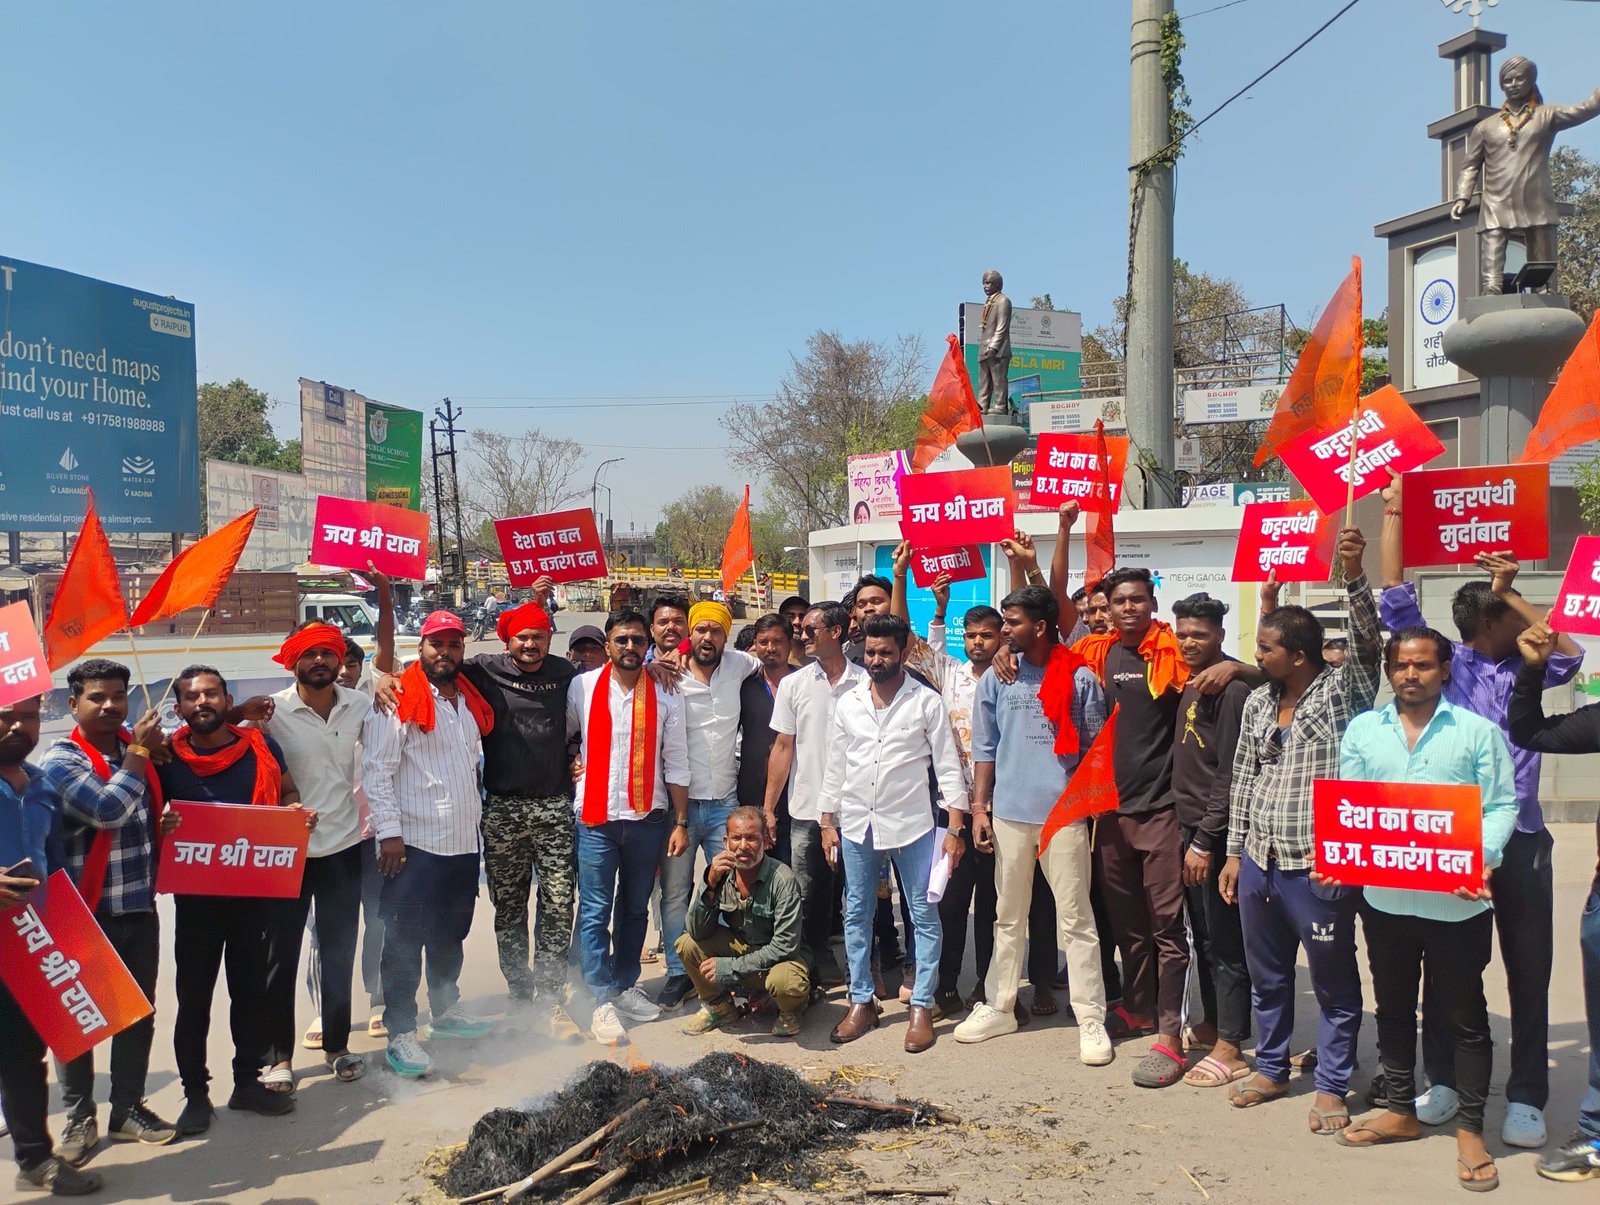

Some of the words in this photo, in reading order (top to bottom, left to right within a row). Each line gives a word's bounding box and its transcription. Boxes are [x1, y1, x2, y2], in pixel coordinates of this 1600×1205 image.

[132, 298, 190, 318] augustprojects.in
[160, 319, 188, 334] RAIPUR
[61, 347, 107, 374] need
[112, 357, 160, 385] maps
[1008, 356, 1038, 369] SLA
[1041, 358, 1065, 371] MRI
[40, 376, 89, 401] your
[93, 376, 152, 409] Home.
[23, 405, 44, 419] call
[46, 411, 60, 421] us
[62, 411, 73, 422] at
[81, 411, 165, 433] +917581988988
[1310, 408, 1385, 458] कट्टरपंथी
[388, 446, 410, 459] SCHOOL
[1049, 446, 1069, 468] देश
[1070, 452, 1087, 470] का
[1334, 439, 1402, 486] मुर्दाबाद
[46, 472, 68, 480] SILVER
[69, 473, 90, 482] STONE
[909, 503, 940, 523] जय
[944, 495, 967, 521] श्री
[969, 497, 1005, 519] राम
[1433, 478, 1516, 516] कट्टरपंथी
[0, 512, 18, 523] sive
[19, 512, 62, 523] residential
[63, 514, 85, 524] projec
[108, 515, 132, 523] almost
[133, 516, 153, 525] yours.
[1260, 510, 1319, 541] कट्टरपंथी
[322, 524, 357, 545] जय
[359, 526, 384, 549] श्री
[385, 533, 421, 556] राम
[512, 531, 536, 550] देश
[536, 531, 556, 547] का
[556, 527, 582, 544] बल
[1438, 516, 1511, 552] मुर्दाबाद
[510, 559, 538, 575] छ.ग.
[538, 550, 576, 572] बजरंग
[576, 550, 599, 567] दल
[921, 554, 940, 573] देश
[938, 547, 971, 570] बचाओ
[1259, 541, 1309, 572] मुर्दाबाद
[1170, 573, 1194, 582] MEGH
[1196, 573, 1227, 582] GANGA
[0, 657, 37, 684] दल
[512, 682, 557, 690] RESTART
[1337, 799, 1374, 830] देश
[1377, 807, 1409, 832] का
[1412, 808, 1453, 834] बल
[174, 841, 216, 865] जय
[219, 838, 250, 867] श्री
[253, 845, 298, 868] राम
[1323, 840, 1368, 867] छ.ग.
[1370, 841, 1434, 872] बजरंग
[1435, 849, 1473, 875] दल
[12, 903, 54, 954] जय
[40, 951, 81, 987] श्री
[61, 980, 108, 1035] राम
